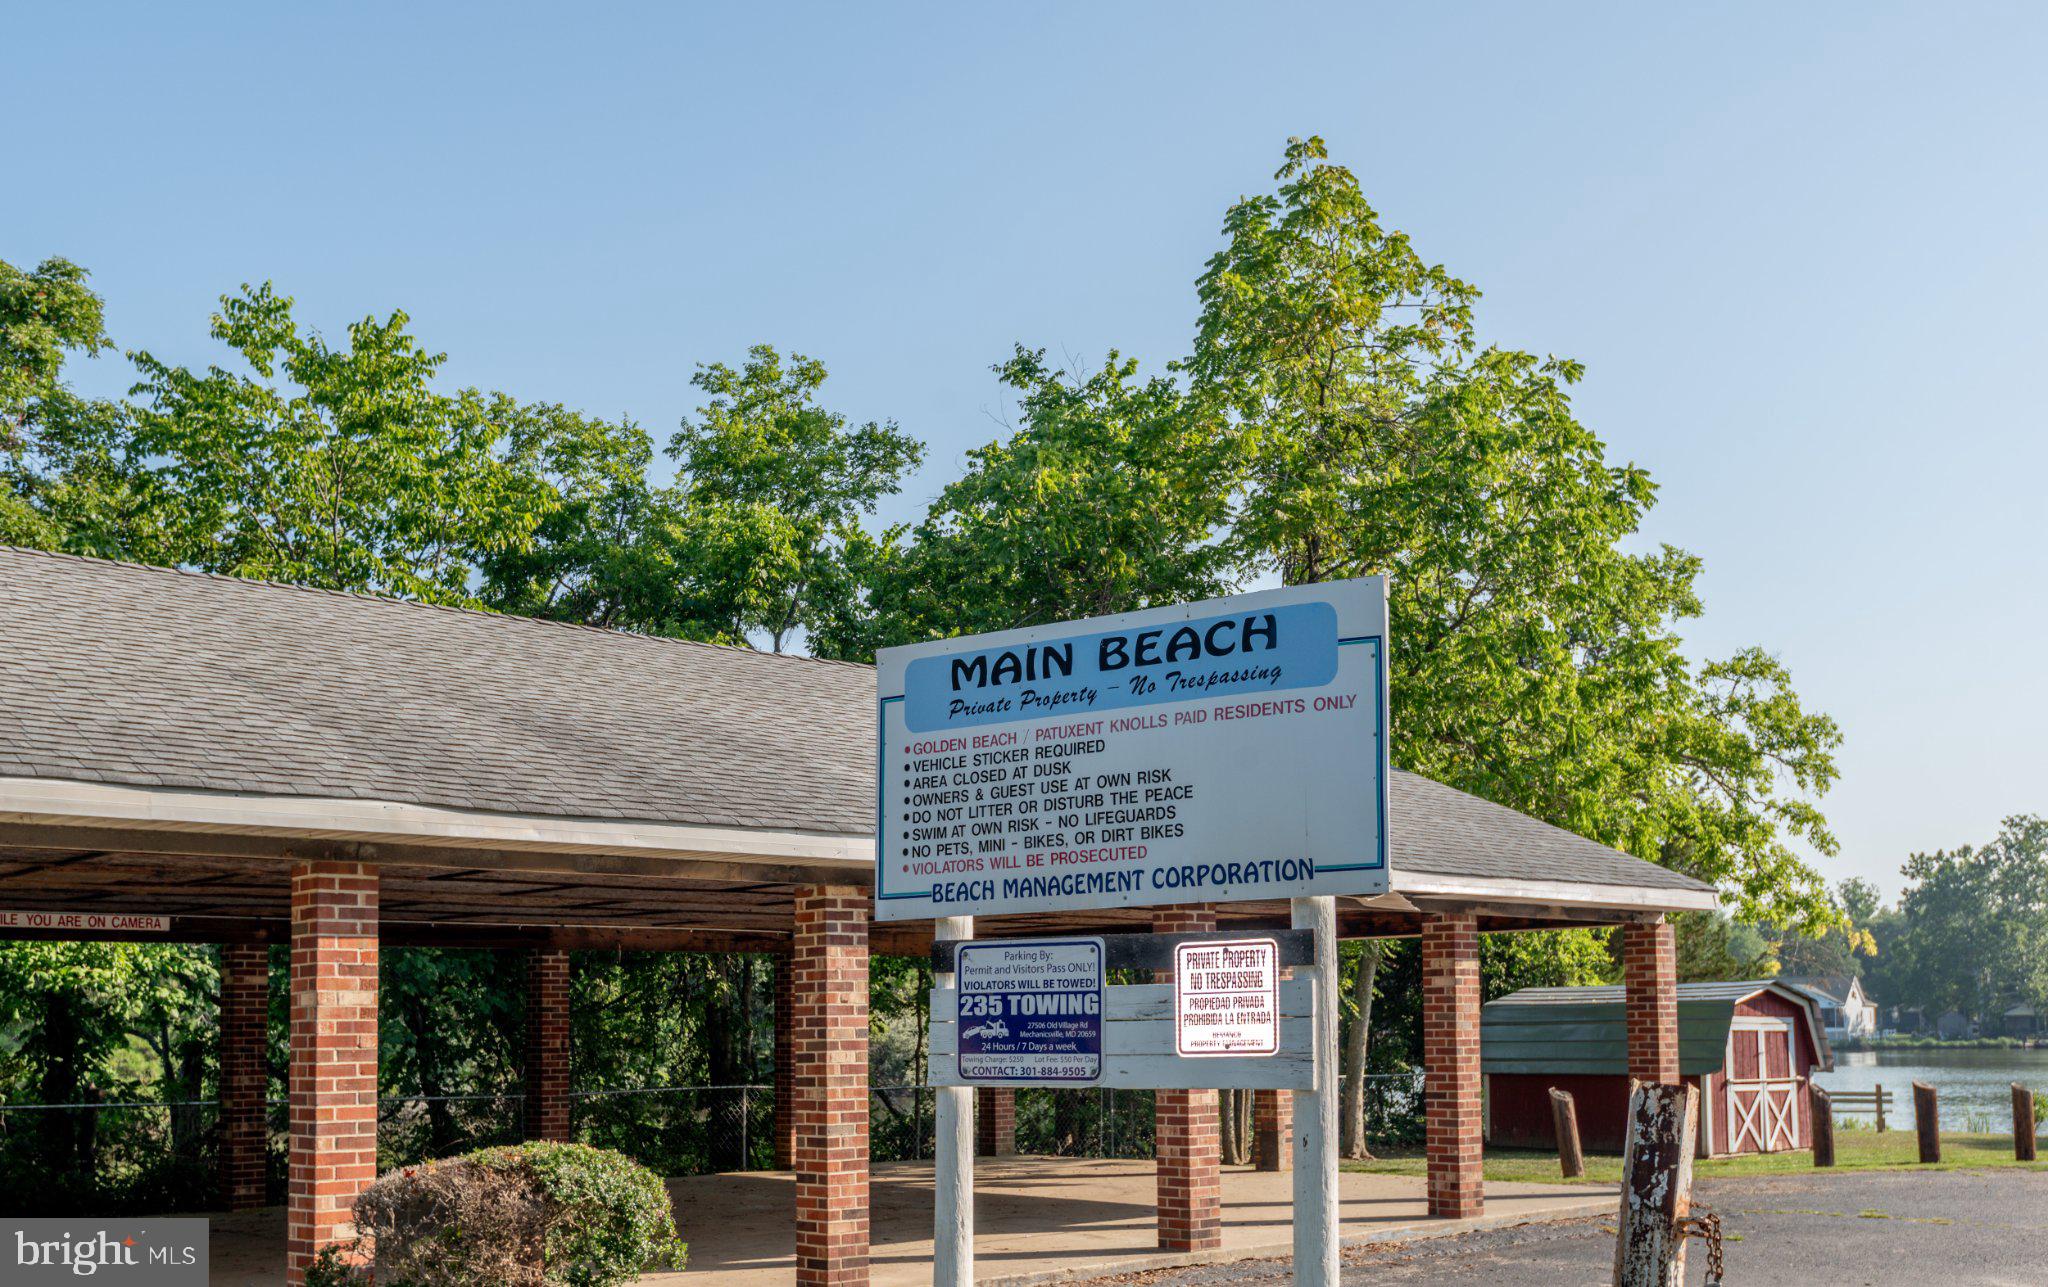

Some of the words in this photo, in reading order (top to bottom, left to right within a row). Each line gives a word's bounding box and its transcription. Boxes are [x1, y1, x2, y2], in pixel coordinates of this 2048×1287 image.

[952, 643, 1073, 691] MAIN
[1100, 614, 1277, 671] BEACH
[949, 699, 1011, 719] Private
[1020, 687, 1097, 711] Property
[1130, 675, 1156, 695] No
[1166, 665, 1282, 692] Trespassing
[913, 738, 967, 755] GOLDEN
[973, 732, 1017, 748] BEACH
[1023, 729, 1029, 744] /
[1036, 721, 1103, 741] PATUXENT
[1110, 712, 1168, 733] KNOLLS
[1175, 709, 1207, 726] PAID
[1215, 699, 1305, 721] RESIDENTS
[1314, 694, 1358, 711] ONLY
[913, 756, 967, 772] VEHICLE
[973, 748, 1029, 766] STICKER
[1035, 740, 1105, 759] REQUIRED
[913, 776, 947, 789] AREA
[953, 769, 1006, 786] CLOSED
[1013, 766, 1028, 779] AT
[1034, 761, 1072, 777] DUSK
[913, 790, 969, 807] OWNERS
[976, 789, 984, 800] &
[991, 783, 1035, 799] GUEST
[1041, 780, 1068, 794] USE
[1075, 777, 1090, 790] AT
[1097, 773, 1131, 789] OWN
[1138, 769, 1172, 784] RISK
[913, 811, 931, 823] DO
[937, 808, 963, 821] NOT
[969, 803, 1013, 819] LITTER
[1019, 800, 1038, 814] OR
[1044, 794, 1104, 811] DISTURB
[1110, 791, 1138, 805] THE
[1145, 785, 1194, 802] PEACE
[912, 827, 947, 841] SWIM
[952, 825, 966, 838] AT
[972, 822, 1002, 836] OWN
[1008, 818, 1039, 833] RISK
[1059, 815, 1079, 828] NO
[1086, 805, 1177, 826] LIFEGUARDS
[912, 845, 931, 858] NO
[937, 842, 973, 856] PETS,
[979, 839, 1005, 853] MINI
[1024, 834, 1068, 849] BIKES,
[1075, 831, 1095, 845] OR
[1102, 828, 1134, 843] DIRT
[1141, 824, 1184, 840] BIKES
[913, 858, 984, 875] VIOLATORS
[990, 856, 1021, 870] WILL
[1027, 854, 1044, 867] BE
[1051, 846, 1147, 865] PROSECUTED
[932, 880, 994, 903] BEACH
[1003, 869, 1145, 899] MANAGEMENT
[1153, 858, 1314, 889] CORPORATION
[26, 914, 52, 926] YOU
[58, 915, 82, 927] ARE
[88, 916, 106, 928] ON
[112, 916, 162, 929] CAMERA
[1005, 951, 1036, 962] Parking
[1040, 950, 1053, 961] By:
[1187, 951, 1219, 969] PRIVATE
[1223, 949, 1266, 968] PROPERTY
[965, 965, 992, 975] Permit
[995, 965, 1011, 974] and
[1013, 964, 1044, 974] Visitors
[1047, 963, 1065, 973] Pass
[1068, 963, 1095, 972] ONLY!
[964, 980, 1016, 990] VIOLATORS
[1018, 980, 1040, 989] WILL
[1043, 980, 1055, 988] BE
[1057, 979, 1096, 988] TOWED!
[1191, 973, 1202, 990] NO
[1206, 971, 1263, 989] TRESPASSING
[960, 995, 1003, 1016] 235
[1008, 993, 1099, 1015] TOWING
[1190, 997, 1231, 1010] PROPIEDAD
[1233, 996, 1264, 1009] PRIVADA
[1058, 1022, 1080, 1030] Village
[1184, 1013, 1222, 1026] PROHIBIDA
[1225, 1013, 1234, 1025] LA
[1237, 1011, 1271, 1024] ENTRADA
[982, 1042, 991, 1050] 24
[992, 1042, 1015, 1051] Hours
[1022, 1042, 1026, 1050] 7
[1029, 1042, 1047, 1052] Days
[1055, 1042, 1077, 1050] week
[1085, 1056, 1097, 1064] Day
[972, 1067, 1018, 1076] CONTACT:
[1020, 1067, 1086, 1076] 301-884-9505
